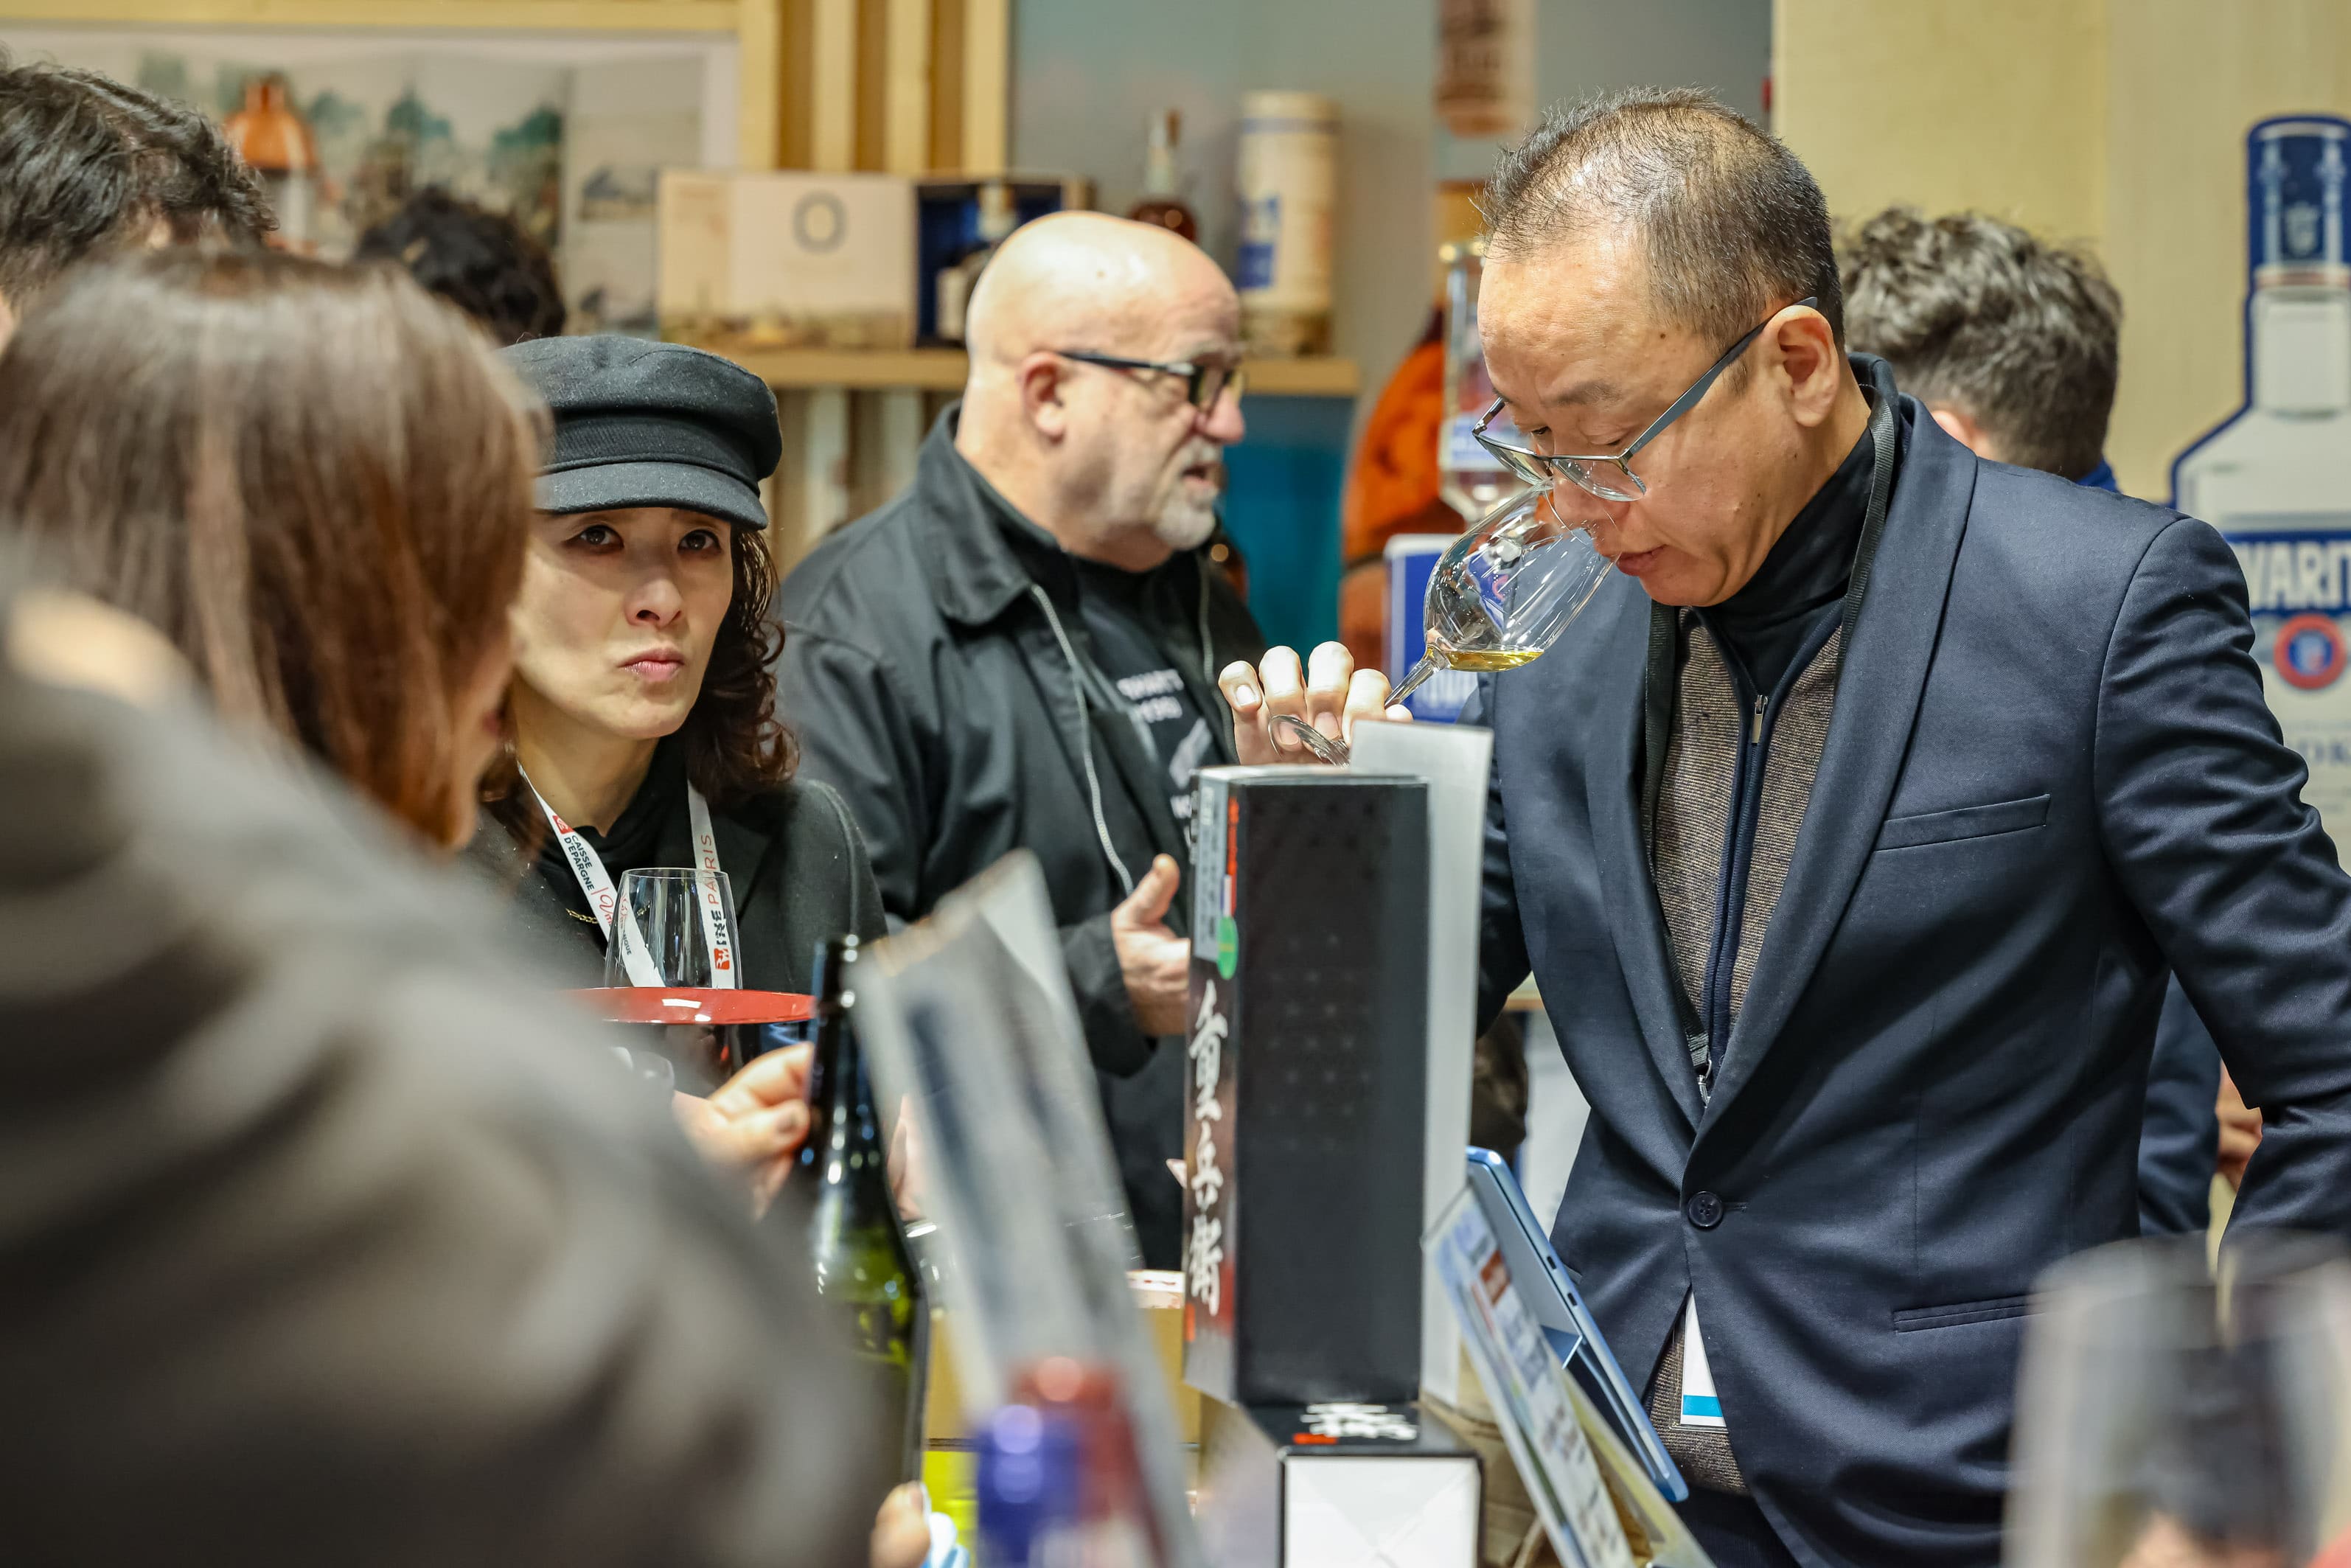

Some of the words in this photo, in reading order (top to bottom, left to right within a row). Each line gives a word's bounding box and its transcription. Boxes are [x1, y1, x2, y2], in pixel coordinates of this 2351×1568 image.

[564, 837, 595, 891] D'EPARGNE
[571, 834, 593, 869] CAISSE
[700, 834, 720, 905] PARIS
